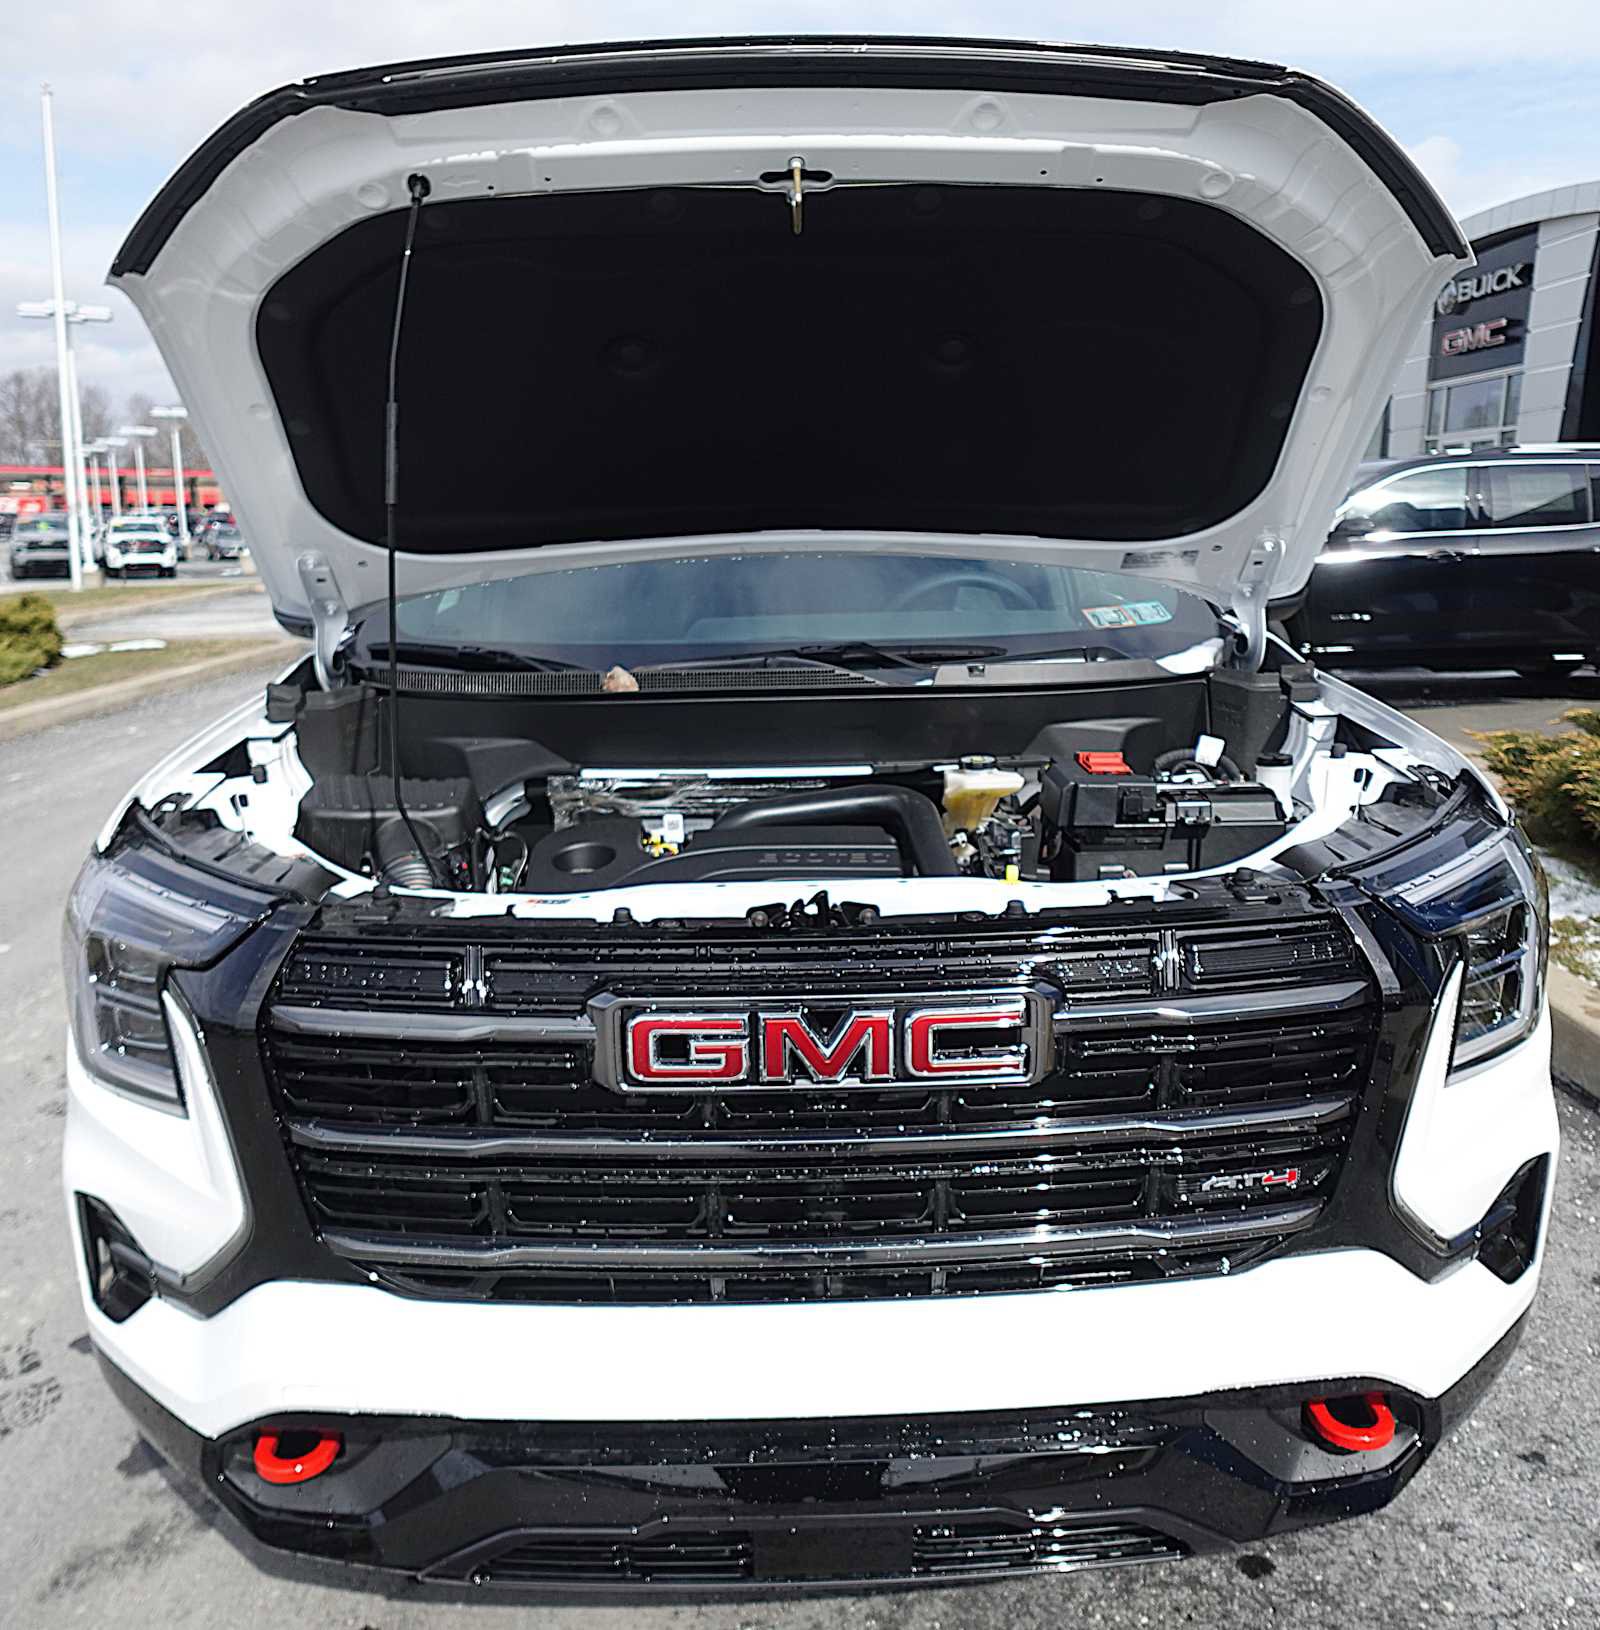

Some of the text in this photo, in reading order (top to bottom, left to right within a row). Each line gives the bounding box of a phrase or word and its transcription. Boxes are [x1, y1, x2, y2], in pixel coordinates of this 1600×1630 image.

[1456, 263, 1525, 304] BUICK
[1442, 317, 1508, 356] GMC
[625, 994, 1026, 1083] GMC
[1201, 1168, 1300, 1192] AT4
